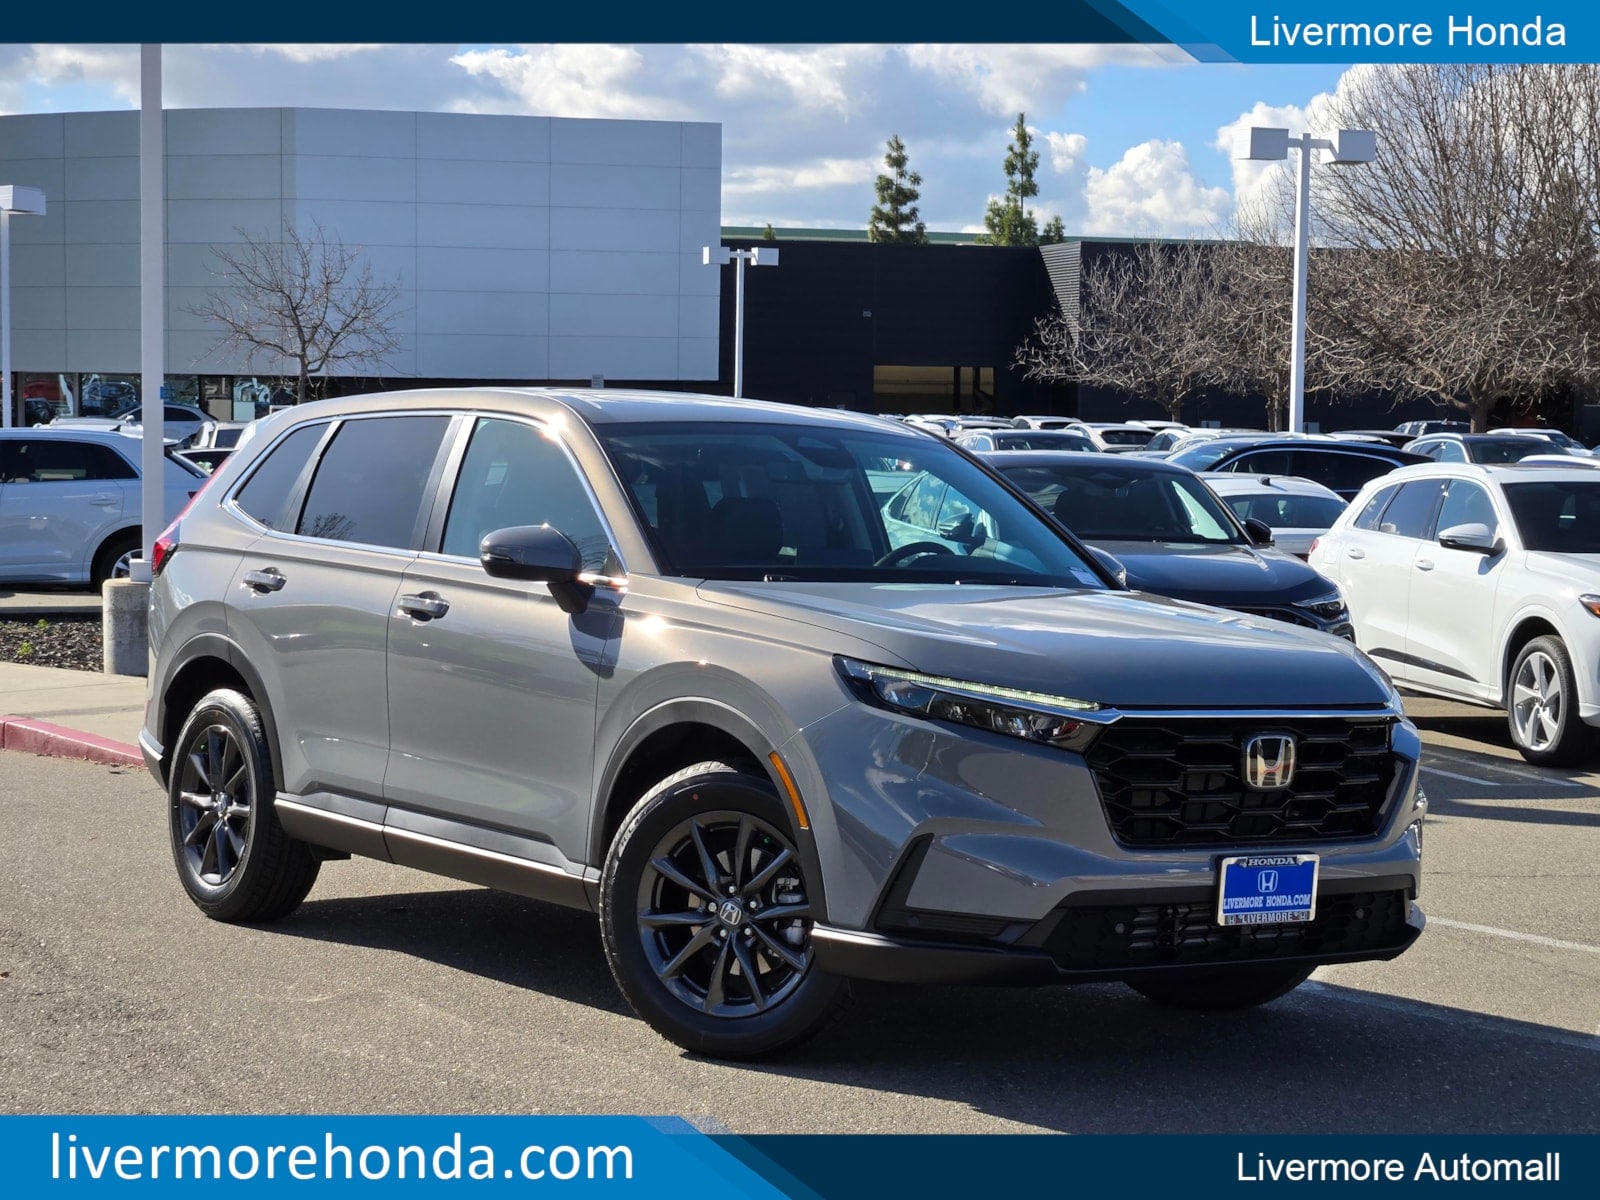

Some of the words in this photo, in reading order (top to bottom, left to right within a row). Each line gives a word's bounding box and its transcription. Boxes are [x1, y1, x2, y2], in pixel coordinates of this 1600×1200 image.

[1249, 857, 1295, 866] HONDA
[1223, 897, 1263, 909] LIVERMORE
[1266, 894, 1311, 907] HONDA.COM
[1242, 912, 1293, 923] LIVERMORE
